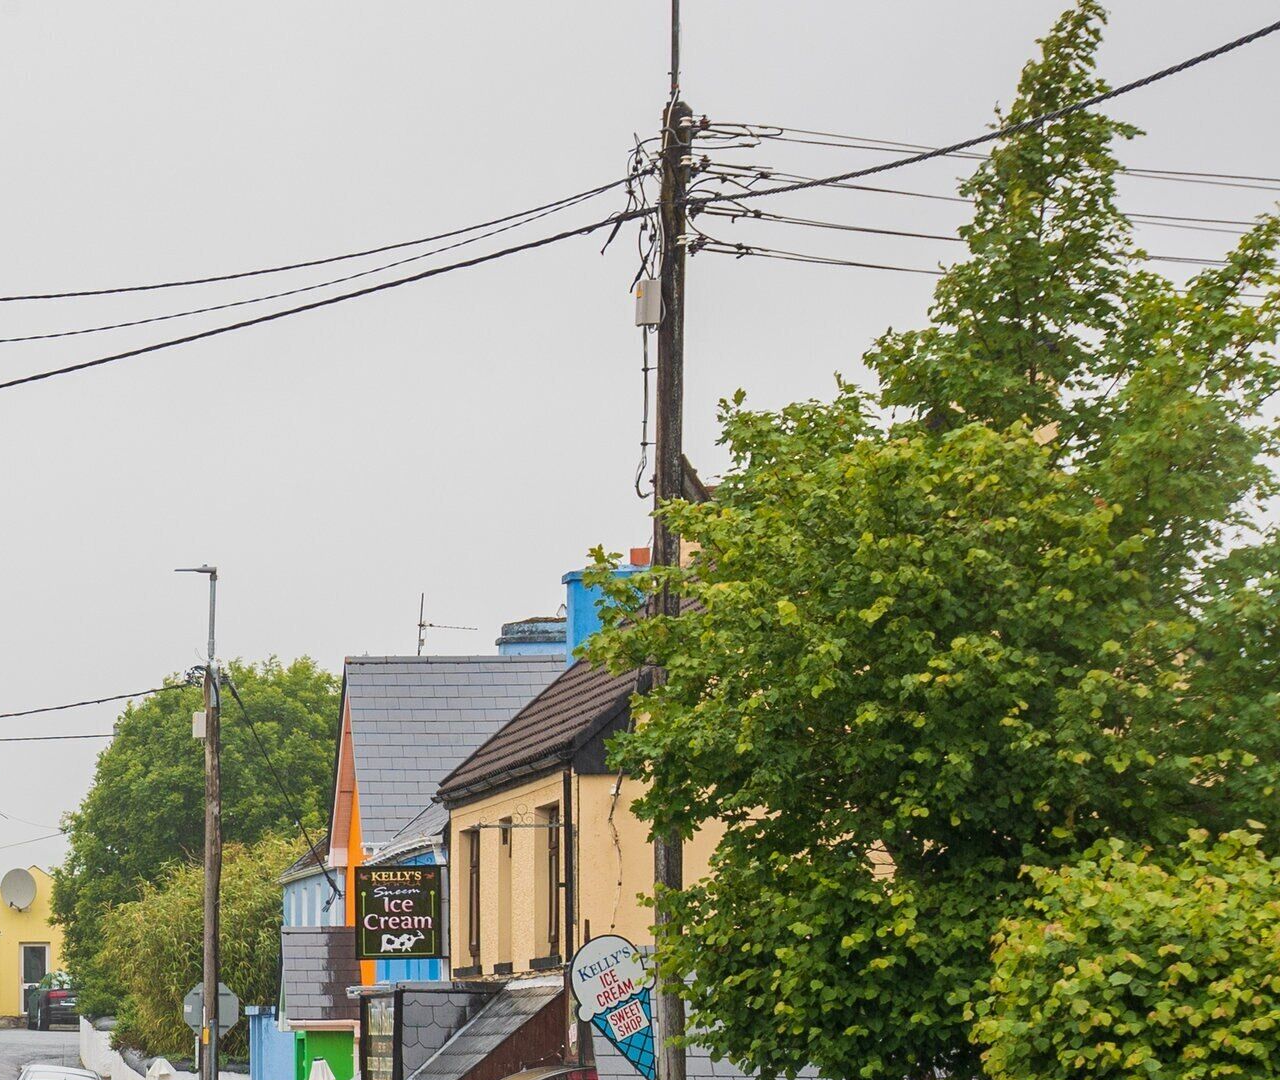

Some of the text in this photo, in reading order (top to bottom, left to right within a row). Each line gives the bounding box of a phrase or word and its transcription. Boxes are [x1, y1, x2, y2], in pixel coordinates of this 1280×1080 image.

[371, 871, 422, 882] KELLY'S
[383, 896, 414, 913] Ice
[363, 913, 433, 930] Cream
[577, 946, 631, 983] KELLY'S
[598, 968, 620, 988] ICE
[596, 977, 635, 1008] CREAM
[610, 1001, 642, 1027] SWEET
[617, 1014, 643, 1038] SHOP
